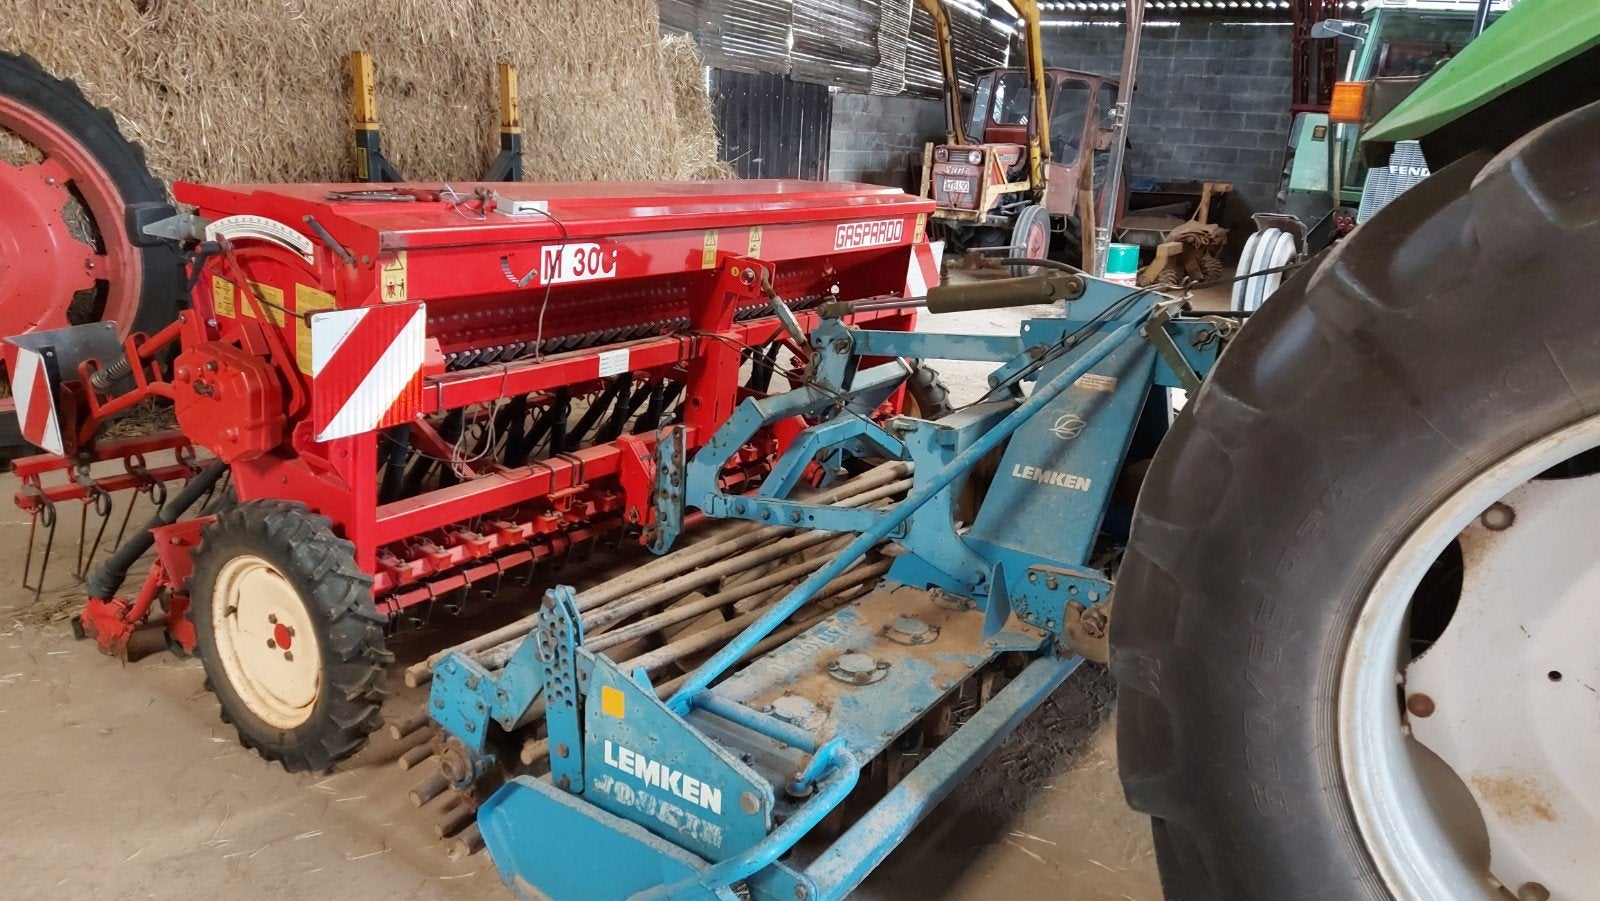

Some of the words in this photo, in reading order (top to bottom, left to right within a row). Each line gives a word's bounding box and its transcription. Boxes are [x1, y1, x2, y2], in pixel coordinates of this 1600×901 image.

[1390, 165, 1430, 177] FEND
[835, 220, 903, 249] GASPARDO
[544, 250, 562, 281] M
[1012, 463, 1092, 492] LEMKEN
[604, 739, 722, 815] LEMKEN
